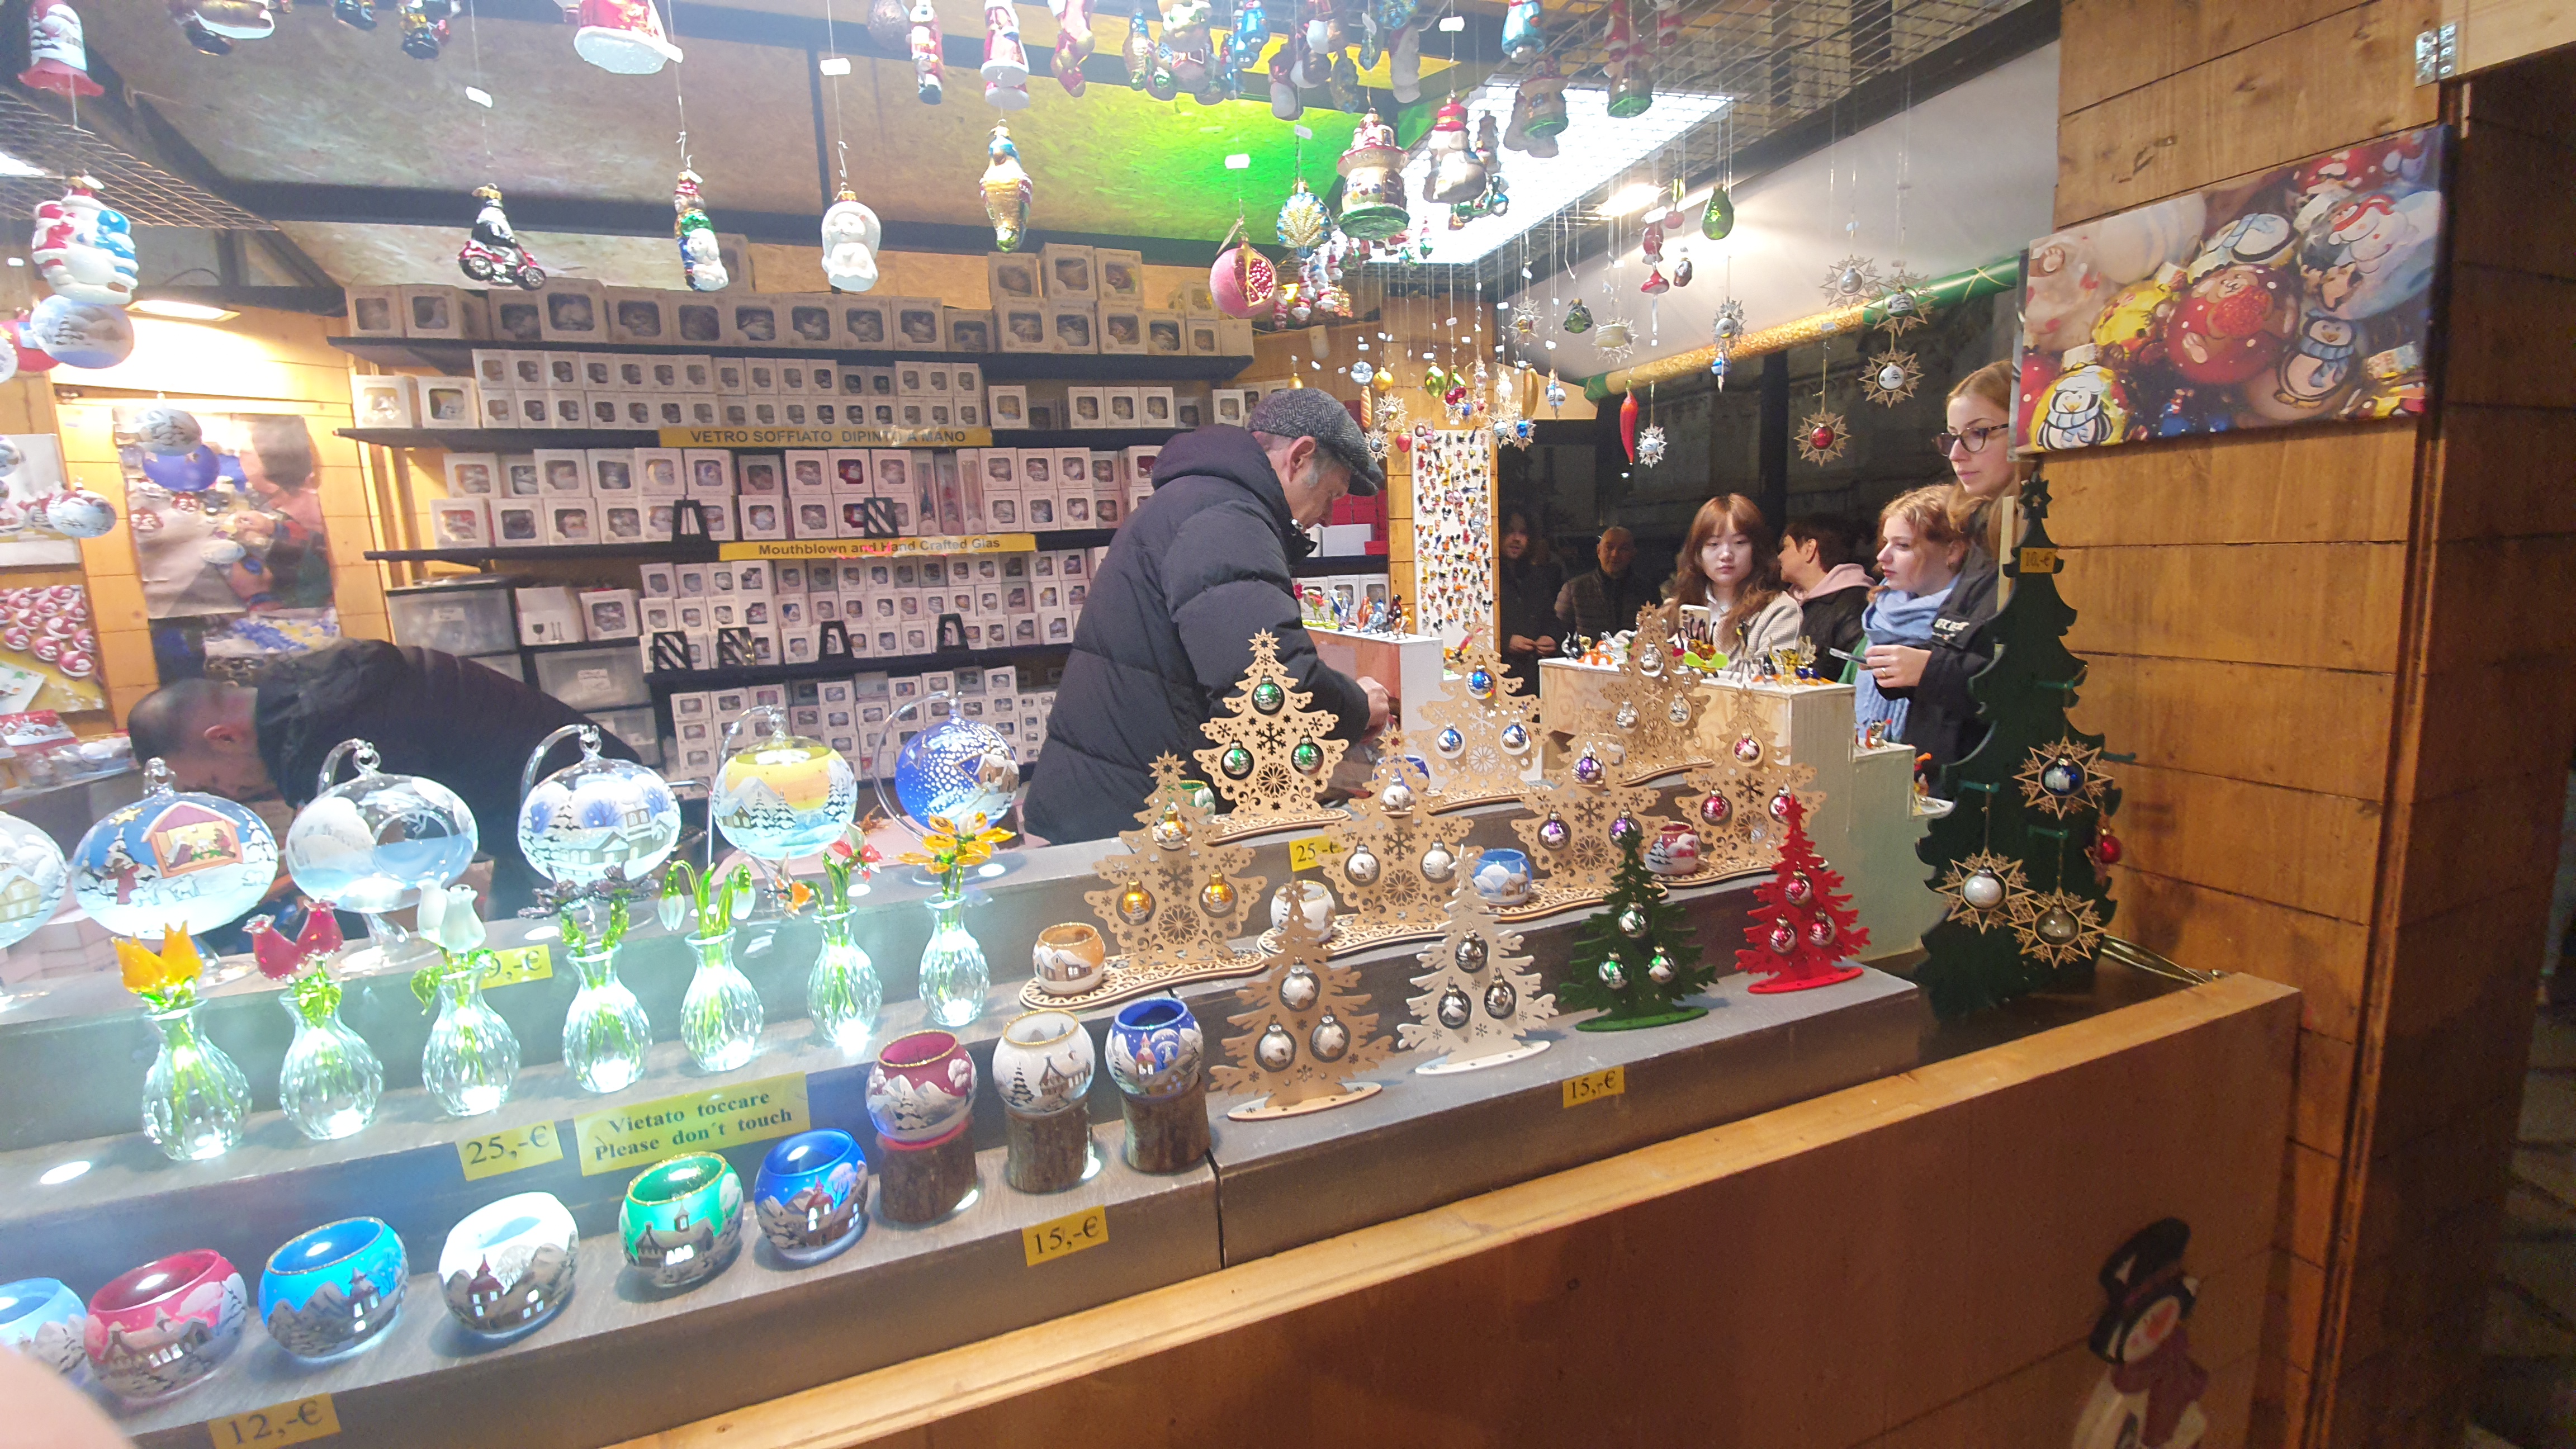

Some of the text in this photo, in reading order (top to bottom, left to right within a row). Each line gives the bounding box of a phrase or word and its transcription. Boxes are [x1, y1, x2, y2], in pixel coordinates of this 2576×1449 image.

[689, 430, 748, 443] VETRO
[752, 430, 832, 443] SOFFIATO
[907, 430, 918, 442] A
[921, 430, 966, 443] MANO
[758, 538, 1001, 555] Mouthblown and Hand Crafted Glas
[1571, 1069, 1616, 1099] 15,-€
[609, 1092, 770, 1134] Vietato toccare
[466, 1125, 550, 1165] 25,-€
[595, 1137, 660, 1161] Please
[737, 1108, 793, 1132] touch
[1034, 1215, 1100, 1255] 15,-€
[229, 1399, 323, 1445] 12,-€
